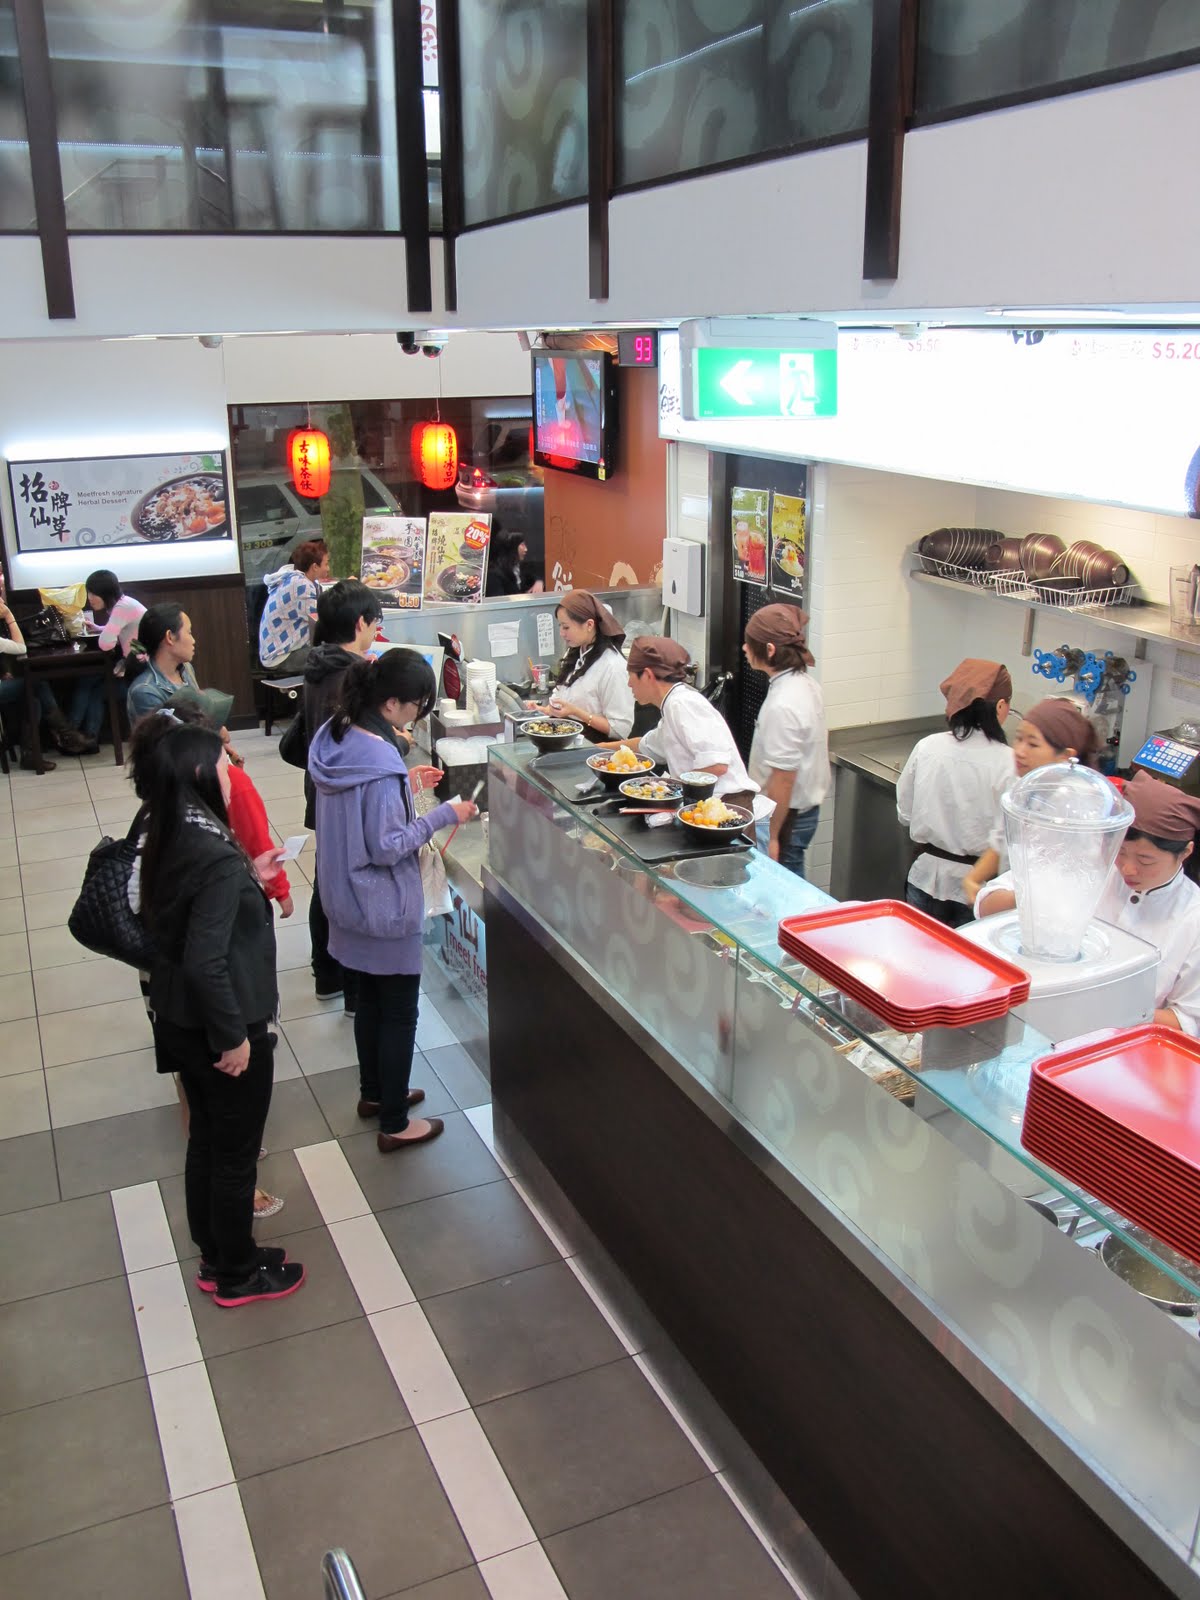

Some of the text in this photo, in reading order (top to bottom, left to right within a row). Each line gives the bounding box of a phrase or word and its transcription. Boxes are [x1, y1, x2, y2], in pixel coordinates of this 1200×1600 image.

[635, 337, 653, 362] 93
[298, 440, 315, 491] 古味茶飲
[465, 526, 487, 544] 20%
[449, 932, 472, 969] meet
